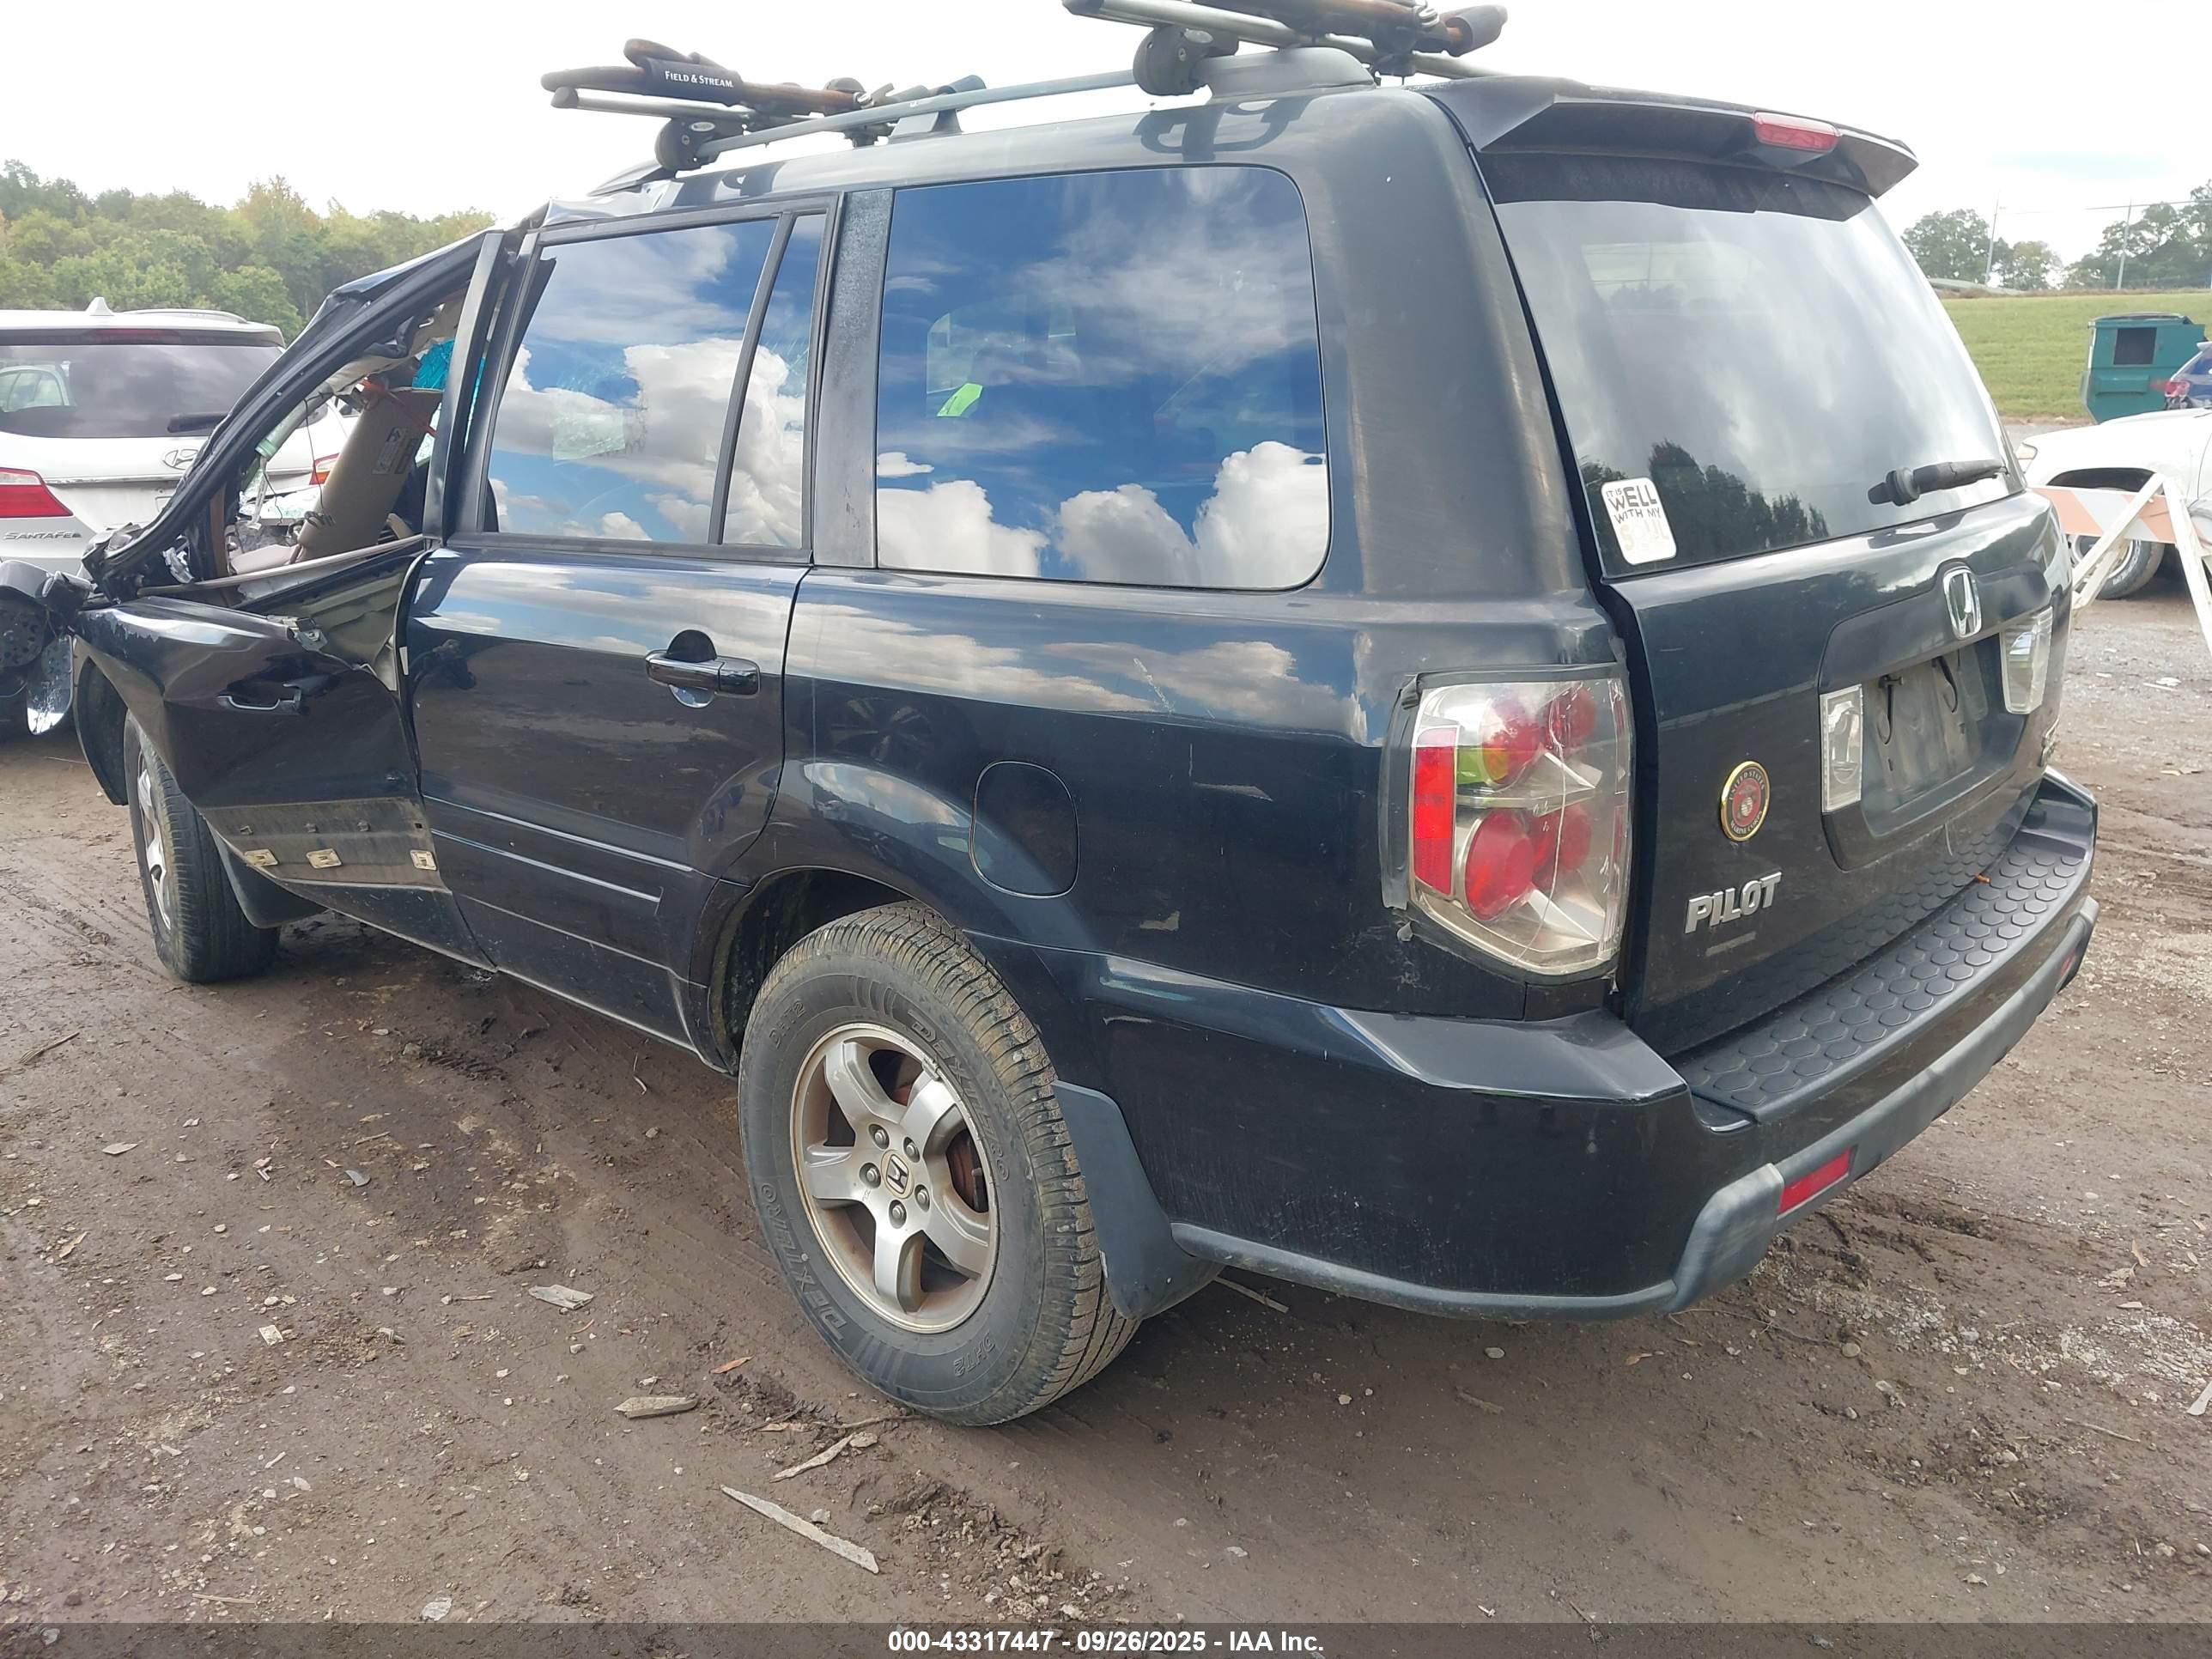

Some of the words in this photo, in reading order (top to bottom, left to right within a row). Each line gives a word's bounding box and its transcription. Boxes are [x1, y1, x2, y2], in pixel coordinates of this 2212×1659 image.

[665, 70, 690, 82] FIELD
[690, 74, 698, 84] &
[698, 75, 733, 88] STREAM
[1608, 484, 1658, 512] WELL
[1613, 508, 1644, 525] WITH
[1647, 507, 1662, 520] MY
[1685, 871, 1783, 934] PILOT
